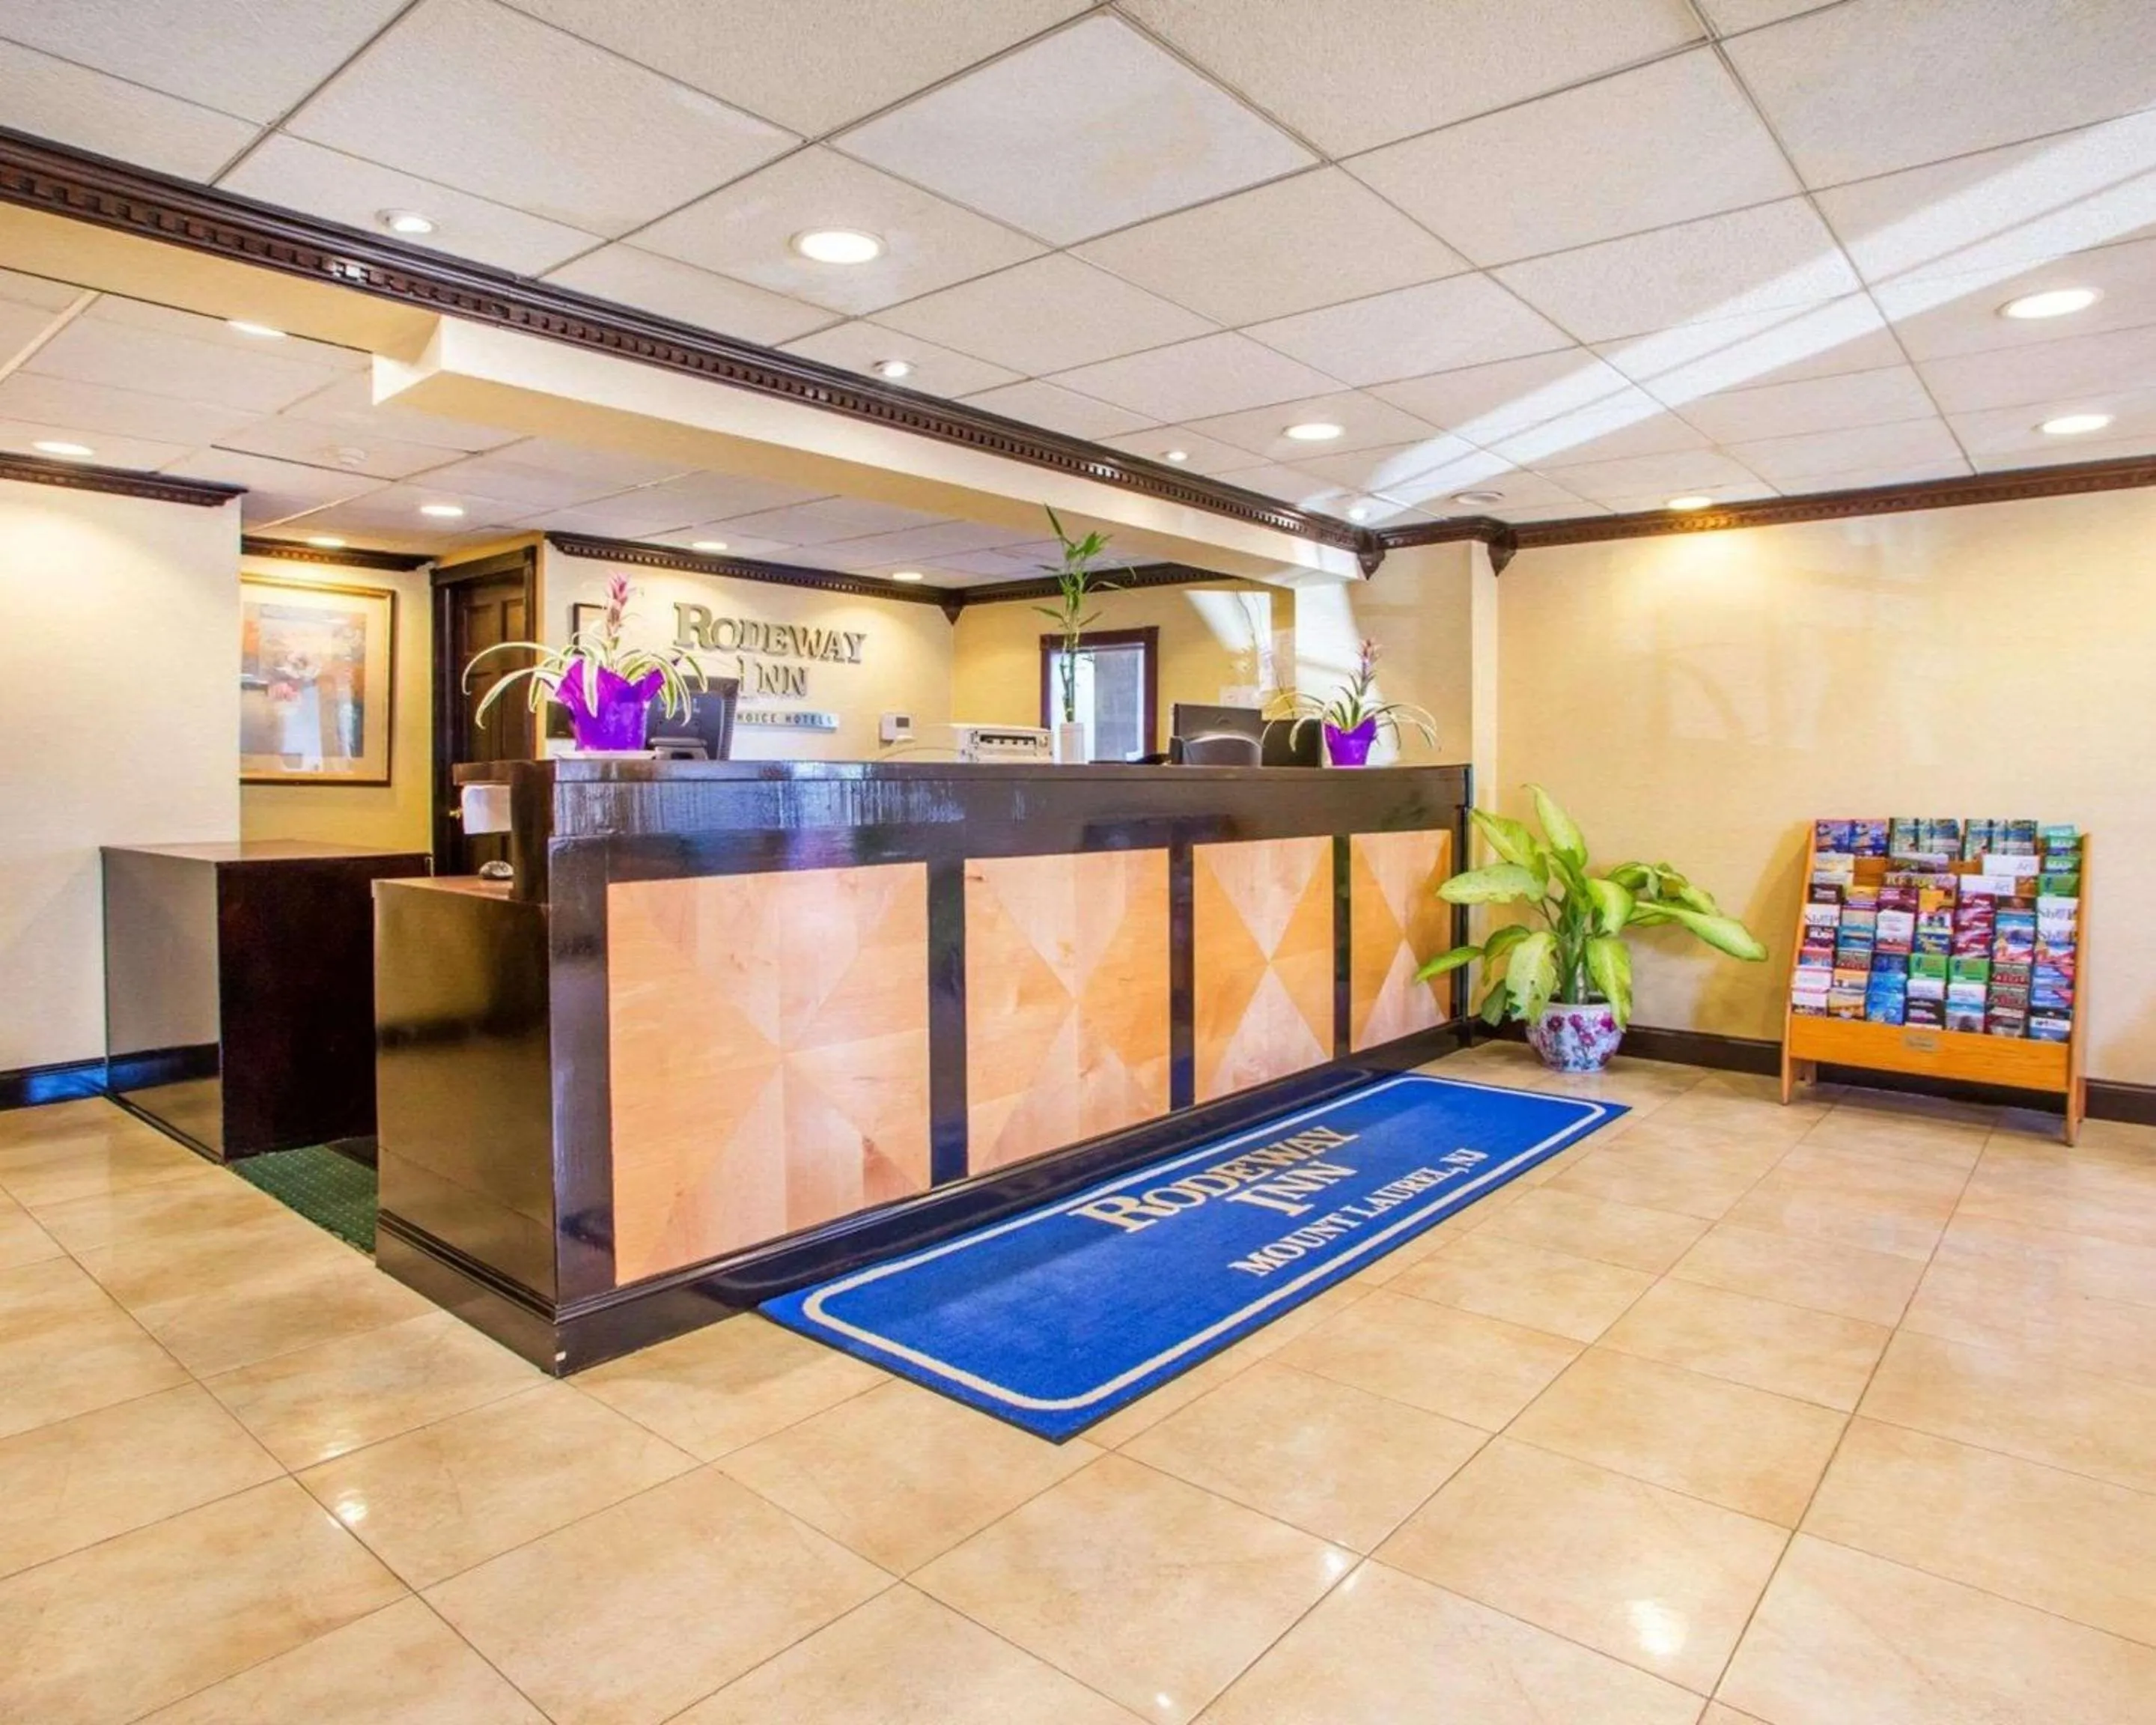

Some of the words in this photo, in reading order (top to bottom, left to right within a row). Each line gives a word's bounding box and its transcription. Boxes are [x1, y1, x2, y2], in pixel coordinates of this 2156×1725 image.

[674, 602, 867, 664] RODEWAY
[737, 655, 809, 699] INN
[737, 712, 776, 724] HOICE
[1067, 1125, 1359, 1233] RODEWAY
[1226, 1160, 1358, 1217] INN
[1228, 1205, 1362, 1277] MOUNT
[1362, 1167, 1469, 1219] LAUREL,
[1440, 1148, 1489, 1168] NJ
